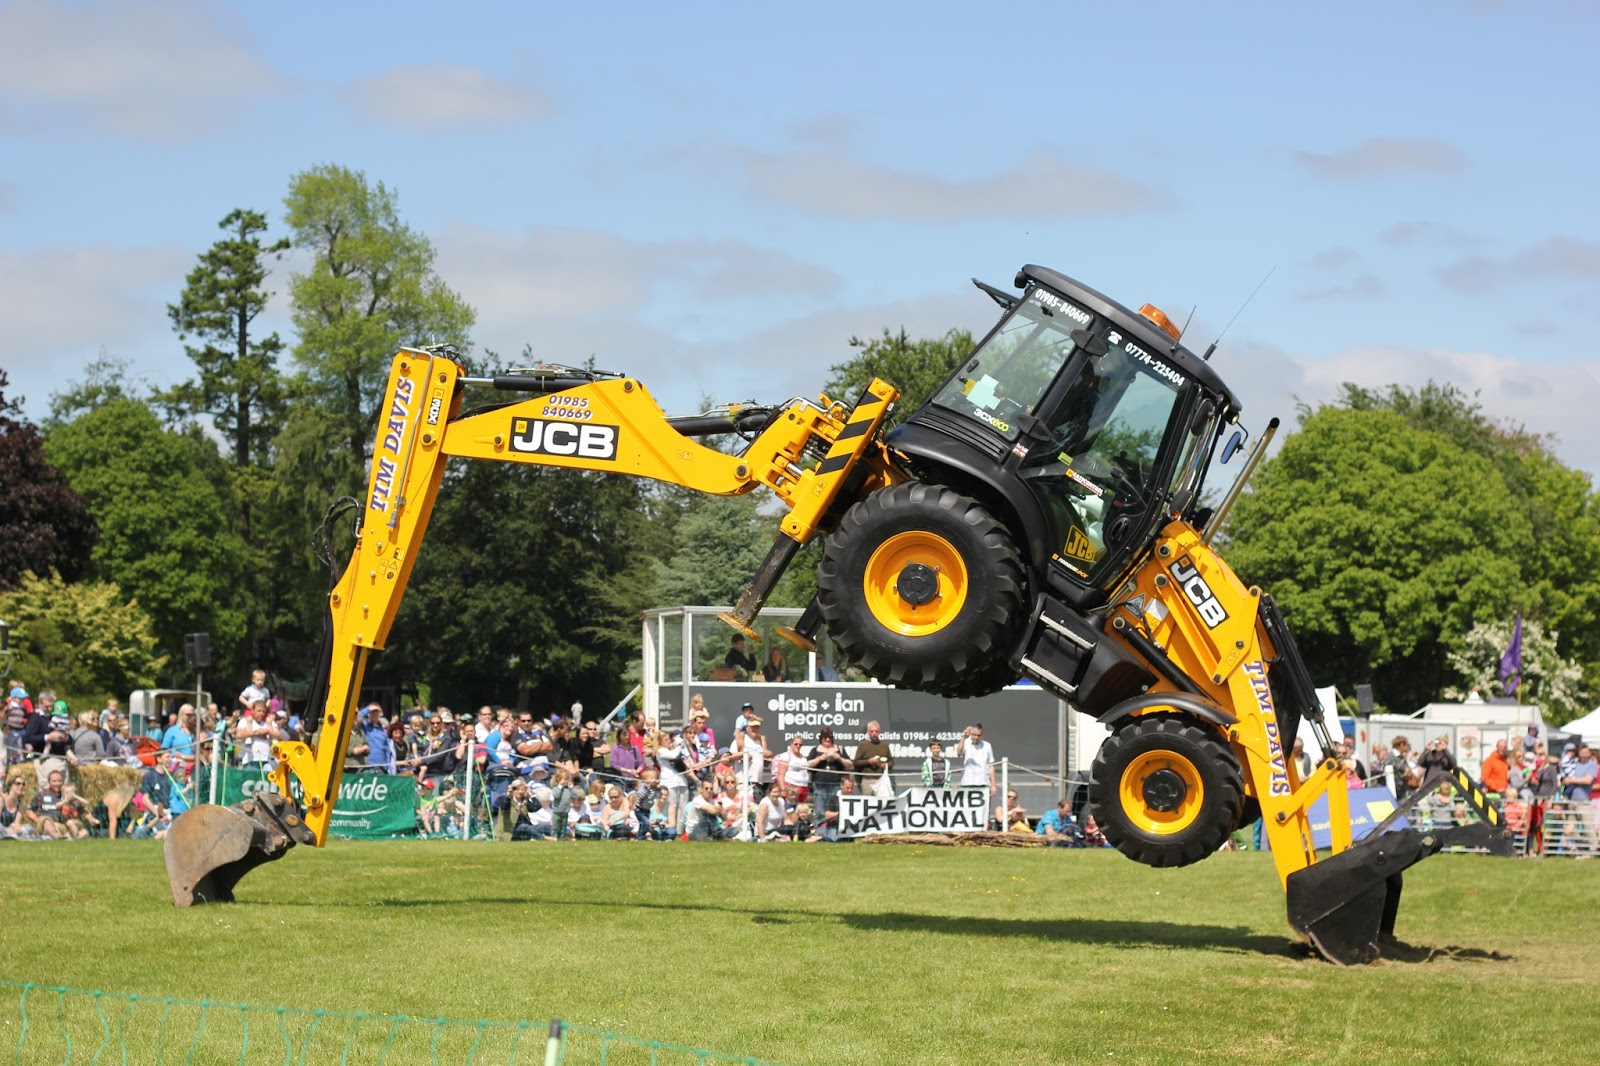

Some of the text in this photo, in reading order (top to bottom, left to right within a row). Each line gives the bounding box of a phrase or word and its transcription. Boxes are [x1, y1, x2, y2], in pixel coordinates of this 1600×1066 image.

[1035, 288, 1090, 325] 01985-840669
[1124, 342, 1186, 387] 07774-225404
[542, 406, 594, 421] 840669
[549, 395, 589, 409] 01985
[370, 375, 415, 513] TIM DAVIS
[513, 420, 615, 459] JCB
[1066, 531, 1097, 561] JCB
[1171, 562, 1226, 628] JCB
[768, 694, 818, 712] denis
[835, 692, 865, 712] ian
[778, 713, 844, 730] pearce
[903, 731, 930, 740] 01984
[1241, 660, 1291, 797] TIM DAVIS
[908, 790, 986, 808] LAMB
[841, 809, 985, 835] NATIONAL
